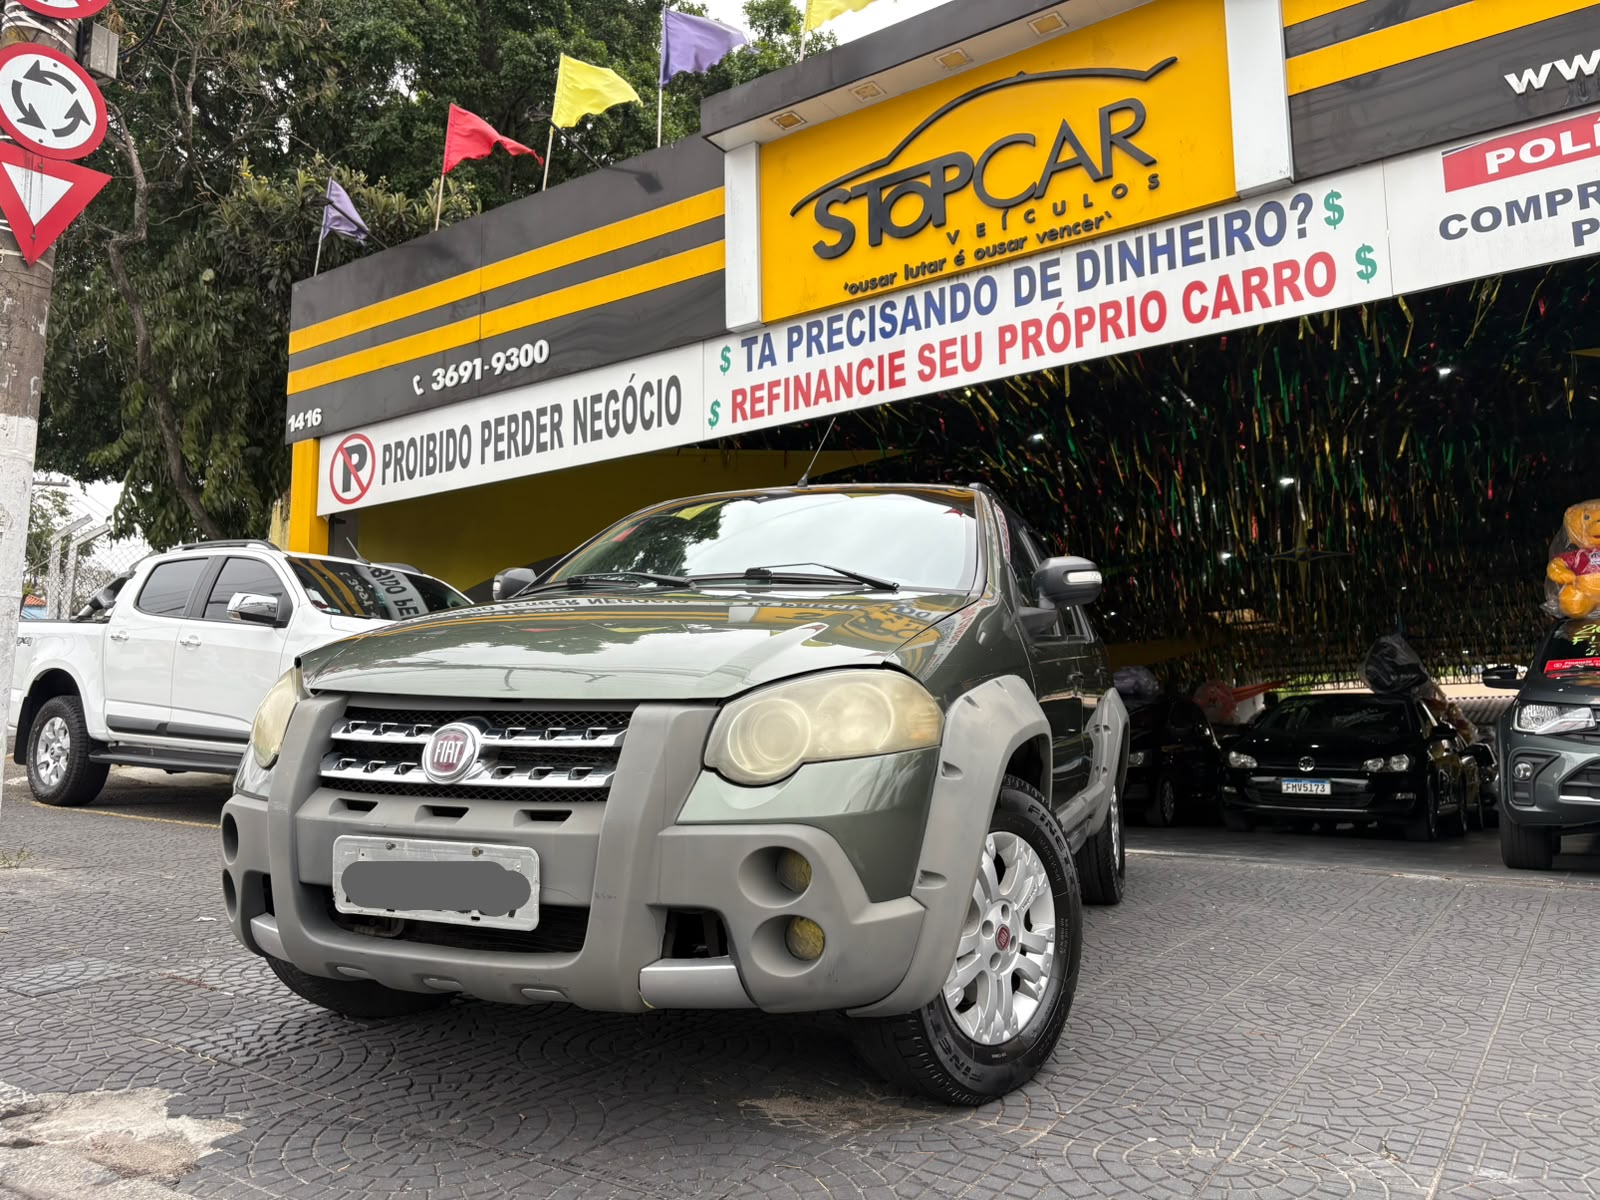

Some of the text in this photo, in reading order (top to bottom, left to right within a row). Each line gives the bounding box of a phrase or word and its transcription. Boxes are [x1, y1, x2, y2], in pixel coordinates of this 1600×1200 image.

[946, 172, 1161, 246] VEÍCULOS
[720, 189, 1345, 376] $ TA PRECISANDO DE DINHEIRO? $
[904, 254, 946, 279] lutar
[953, 250, 965, 267] é
[974, 236, 1028, 262] ousar
[431, 339, 550, 391] 3691-9300
[708, 243, 1378, 430] $ REFINANCIE SEU PRÓPRIO CARRO $
[288, 407, 322, 432] 1416
[381, 424, 472, 486] PROIBIDO
[480, 402, 564, 465] PERDER
[573, 373, 682, 446] NEGÓCIO
[433, 740, 464, 763] FIAT
